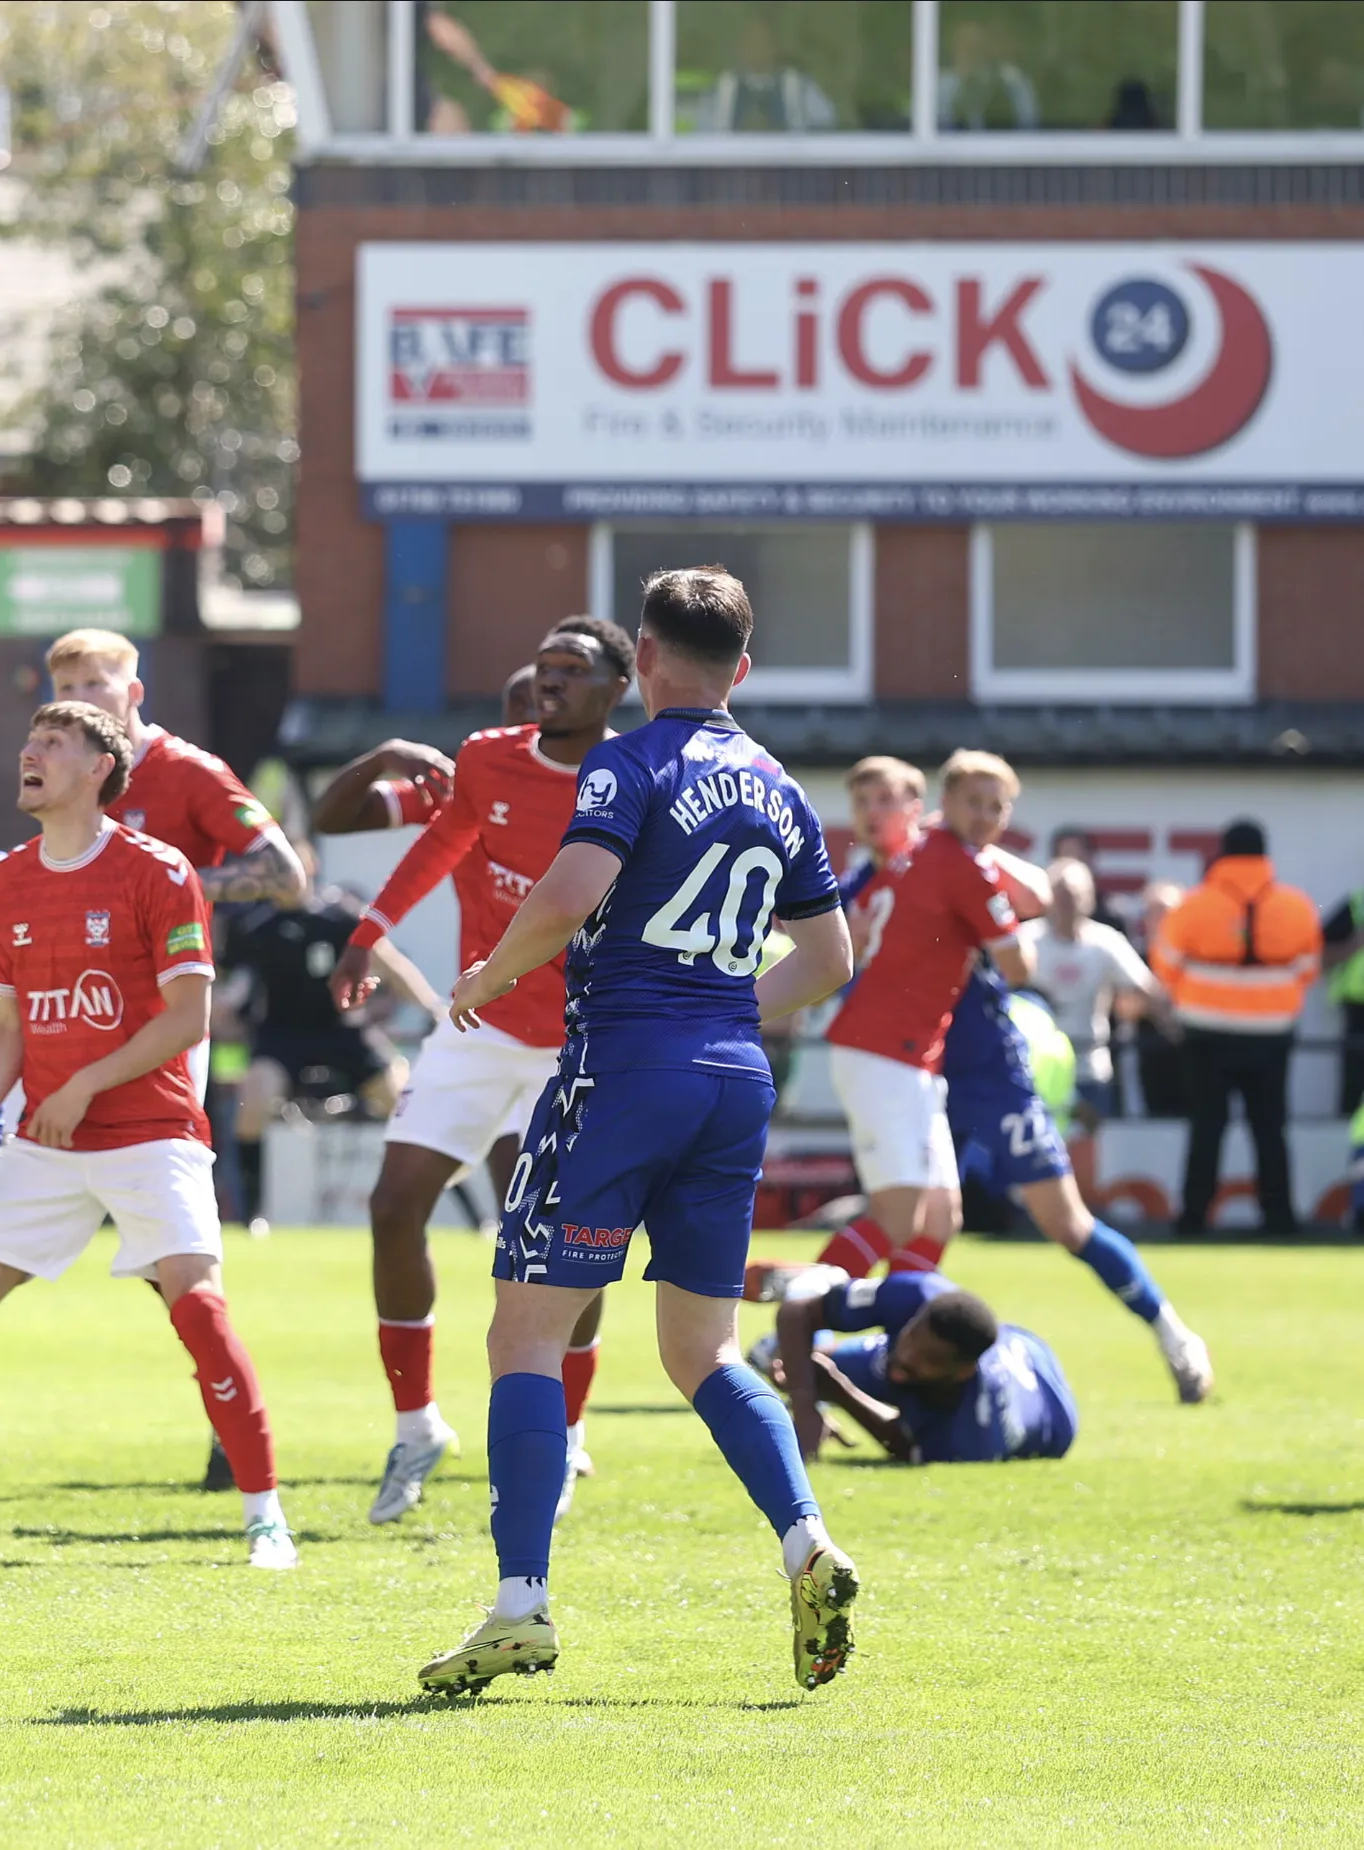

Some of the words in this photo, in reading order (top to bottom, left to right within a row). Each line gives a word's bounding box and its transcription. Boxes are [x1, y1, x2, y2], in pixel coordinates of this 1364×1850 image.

[1103, 306, 1173, 354] 24
[584, 408, 649, 438] Fire
[659, 408, 684, 439] &
[696, 408, 830, 446] Security
[841, 408, 1058, 439] Maintenance
[669, 771, 805, 860] HENDERSON
[487, 860, 534, 897] TIT
[641, 842, 784, 977] 40
[27, 986, 114, 1021] TITAN
[561, 1223, 634, 1248] TARGE
[562, 1249, 584, 1259] FIRE
[588, 1250, 624, 1261] PROTECT
